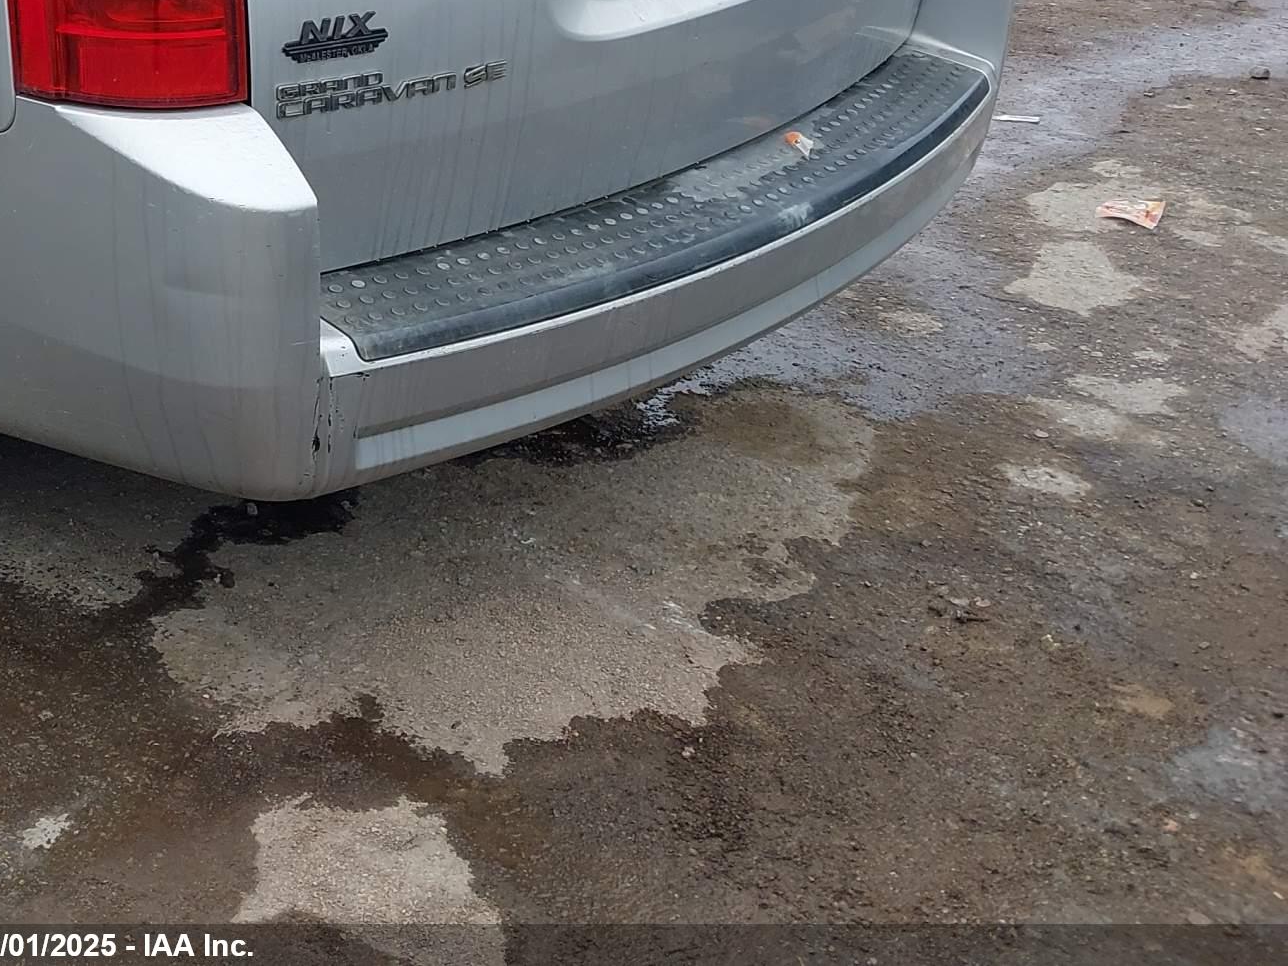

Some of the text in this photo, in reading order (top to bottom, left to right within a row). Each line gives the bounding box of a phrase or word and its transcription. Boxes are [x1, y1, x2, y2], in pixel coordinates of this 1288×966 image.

[298, 11, 376, 45] NIX
[276, 71, 383, 101] GRAND
[276, 60, 508, 119] CARAVAN SE
